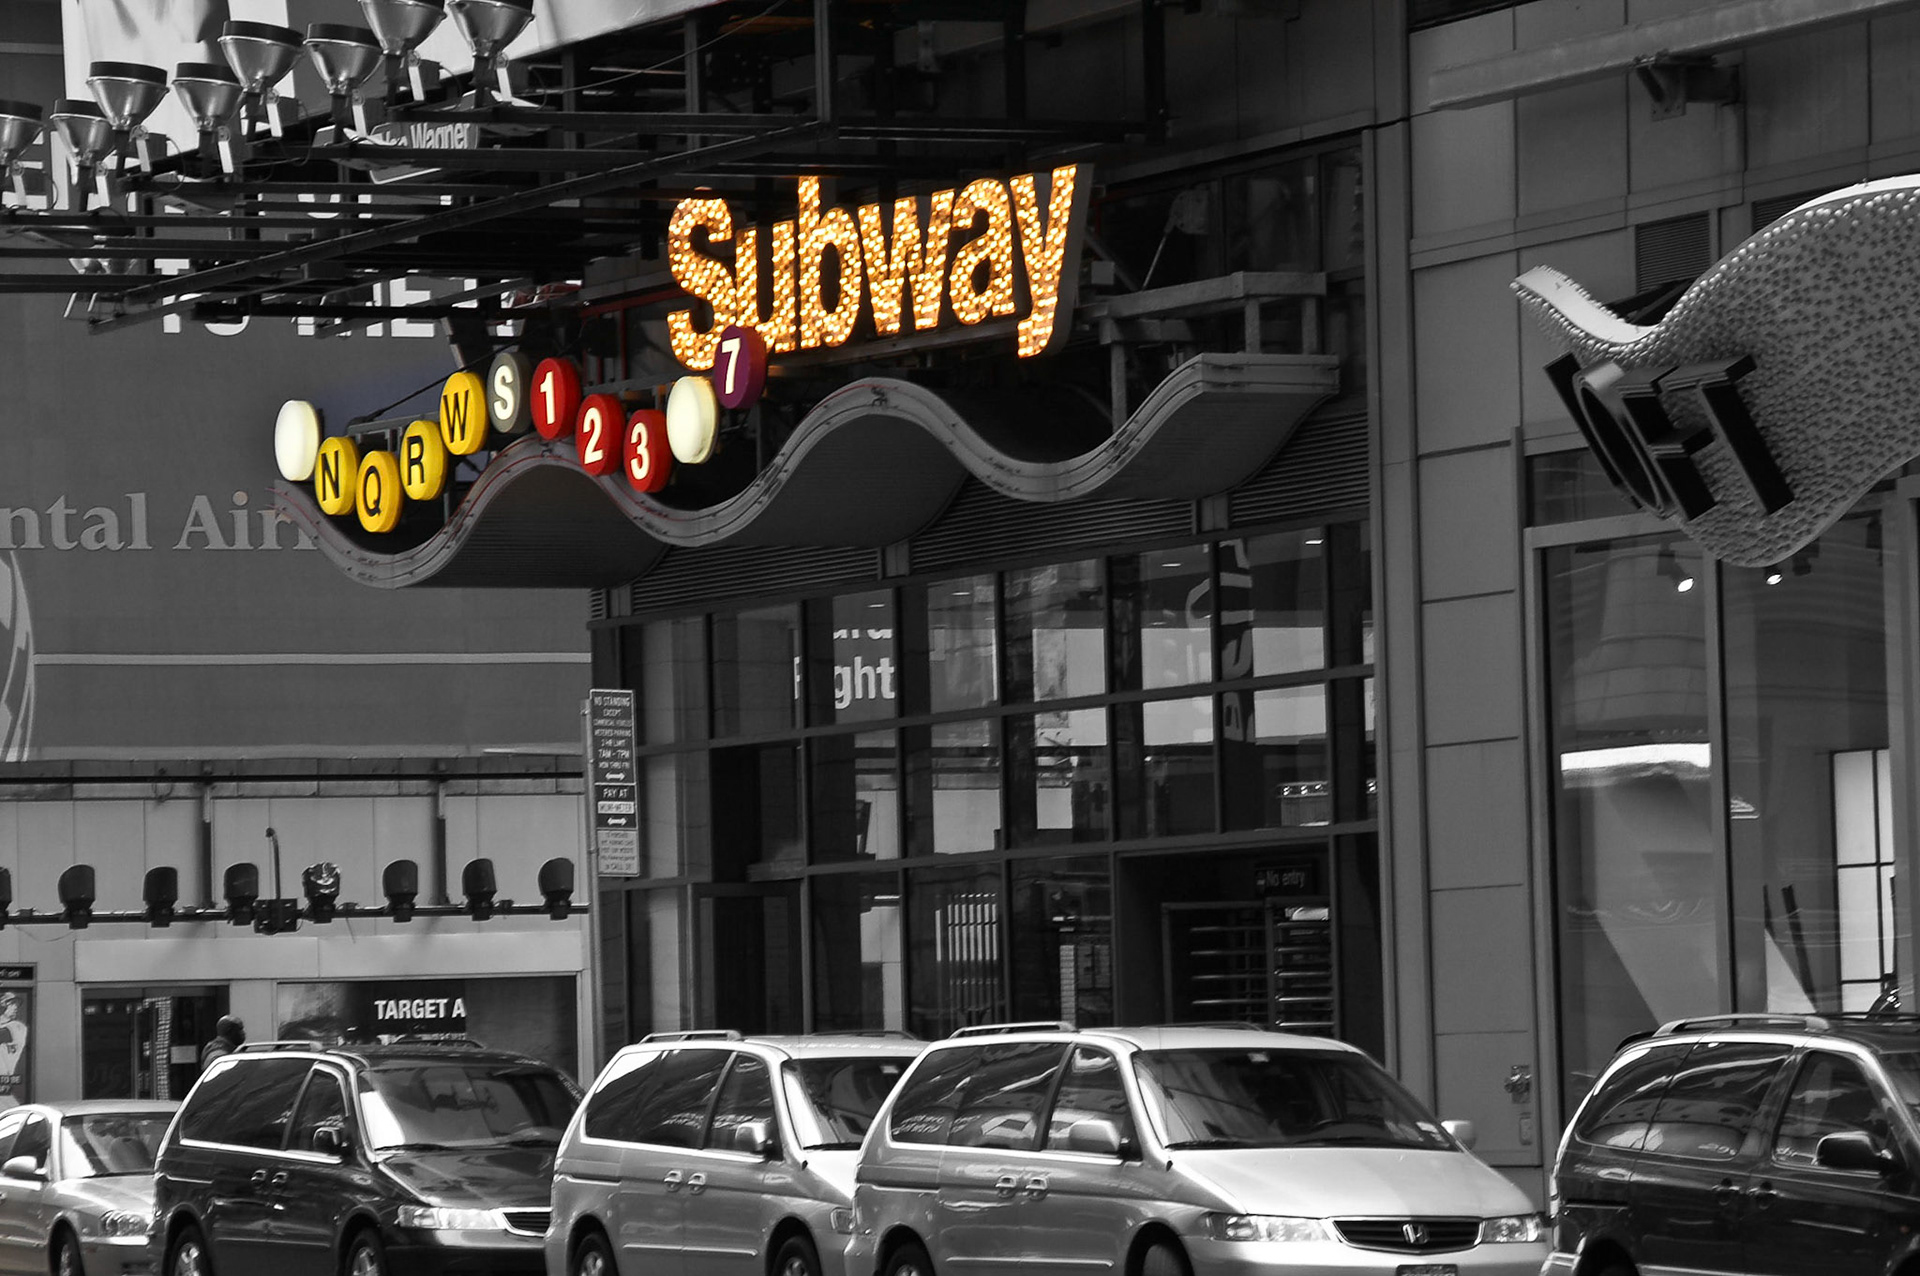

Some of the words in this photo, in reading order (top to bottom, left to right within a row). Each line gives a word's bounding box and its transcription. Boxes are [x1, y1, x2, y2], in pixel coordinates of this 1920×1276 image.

[667, 165, 1078, 371] Subway
[320, 450, 341, 503] N
[363, 465, 382, 518] Q
[406, 435, 426, 487] R
[442, 389, 470, 445] W
[493, 364, 514, 421] S
[540, 371, 556, 425] 1
[582, 406, 604, 465] 2
[630, 422, 650, 480] 3
[721, 337, 742, 395] 7
[0, 492, 153, 551] ntal
[603, 696, 630, 707] STANDING
[603, 787, 617, 799] PAY
[619, 787, 628, 799] AT
[374, 997, 449, 1020] TARGET
[451, 996, 466, 1019] A
